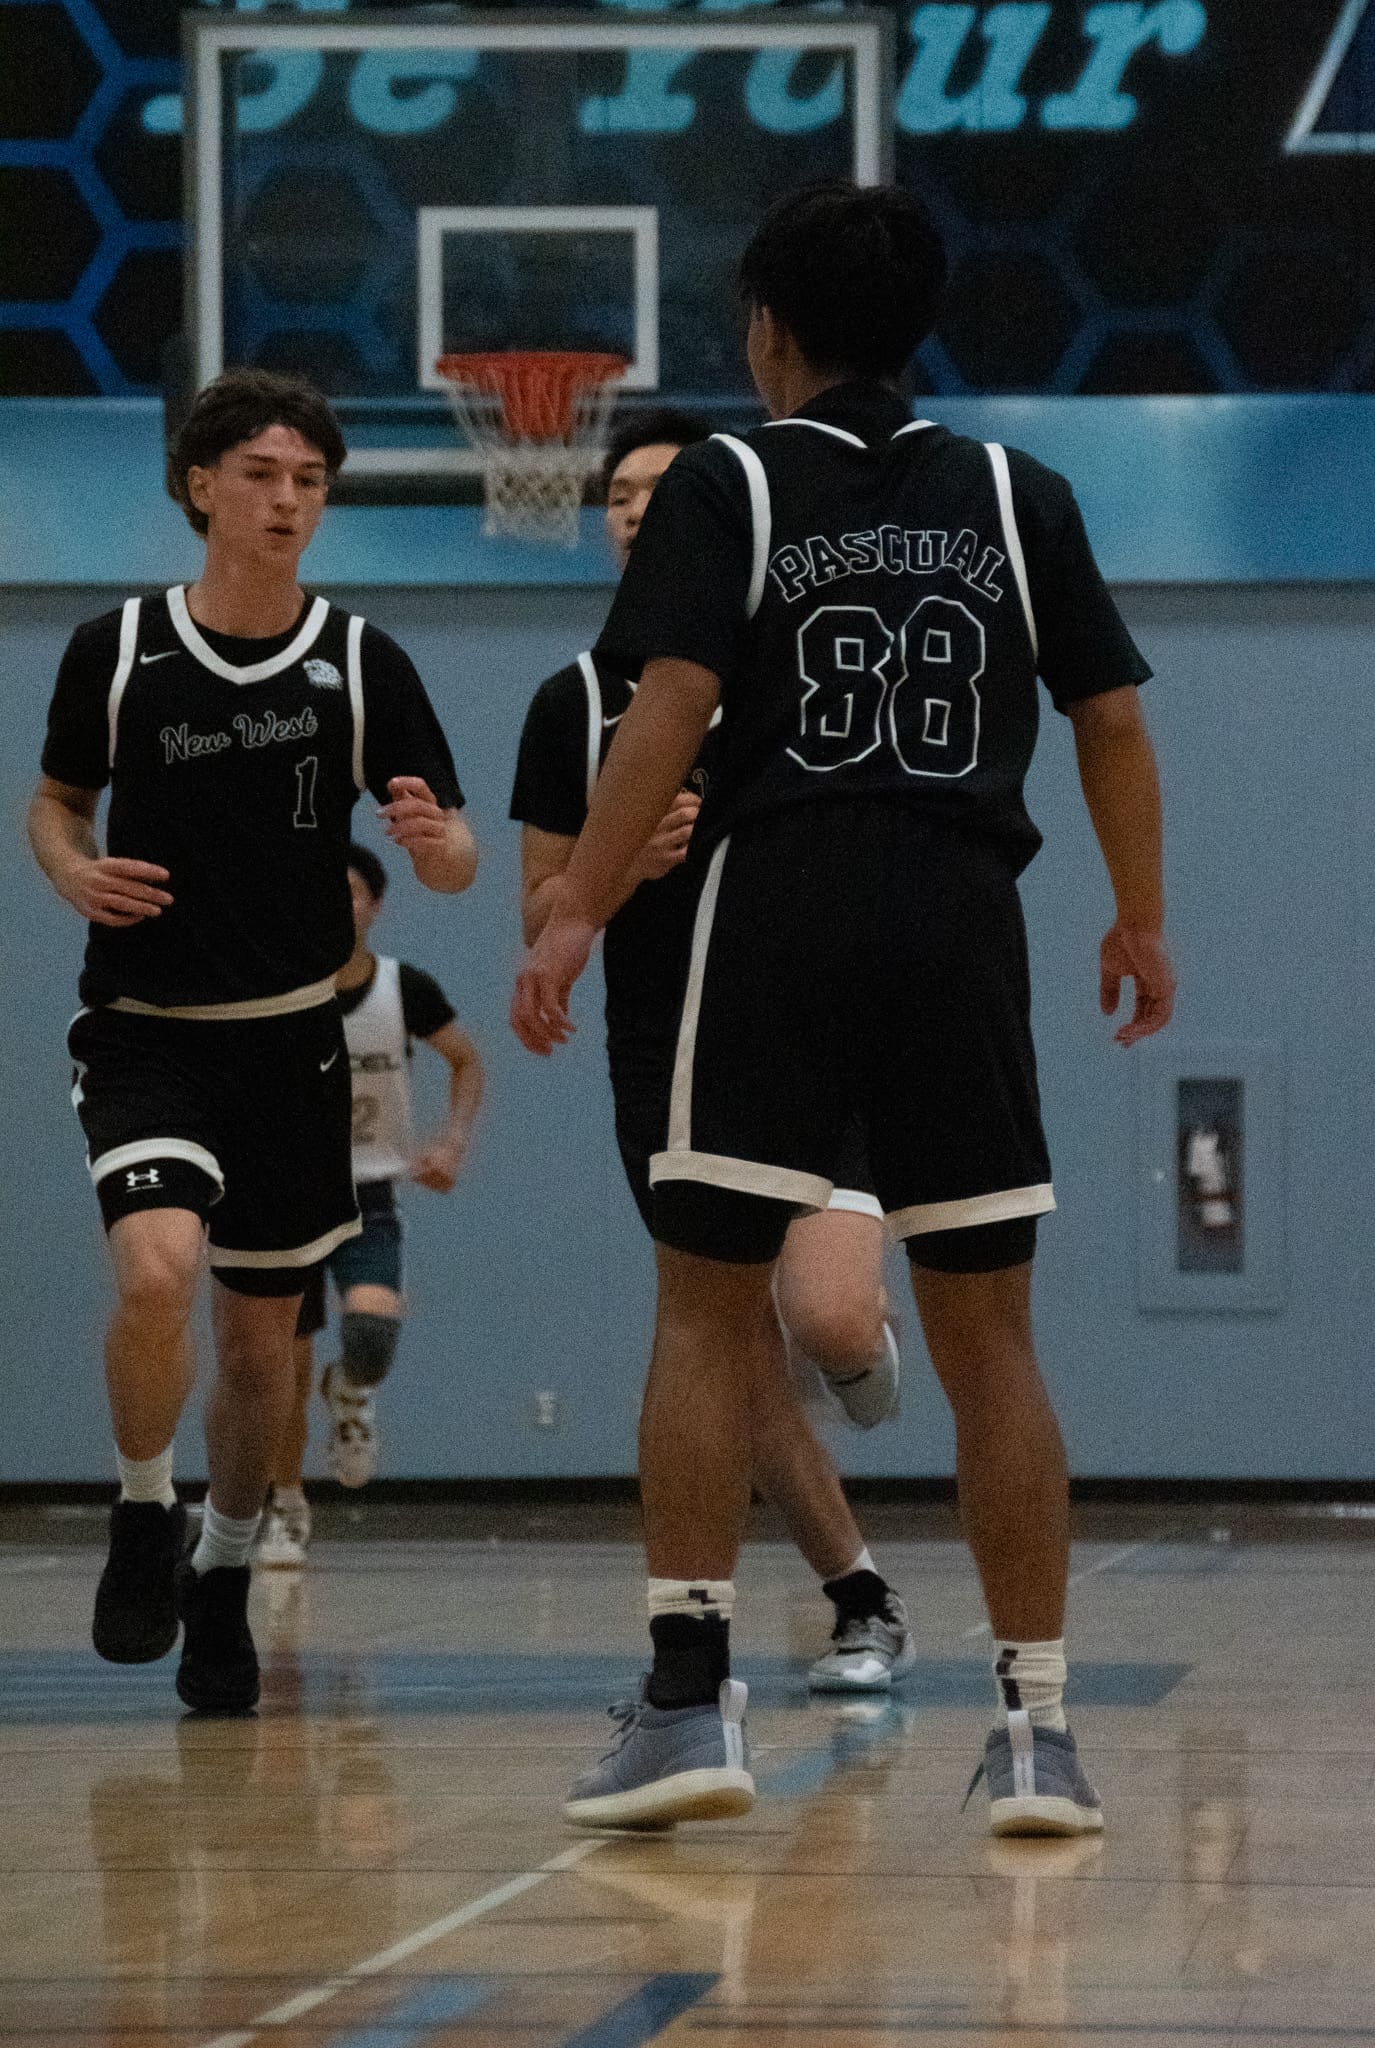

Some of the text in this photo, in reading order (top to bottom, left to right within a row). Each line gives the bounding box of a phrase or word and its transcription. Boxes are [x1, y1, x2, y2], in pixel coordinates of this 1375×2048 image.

[768, 524, 1006, 603] PASCUAL
[785, 595, 986, 778] 88
[159, 706, 319, 765] New West
[292, 755, 319, 829] 1
